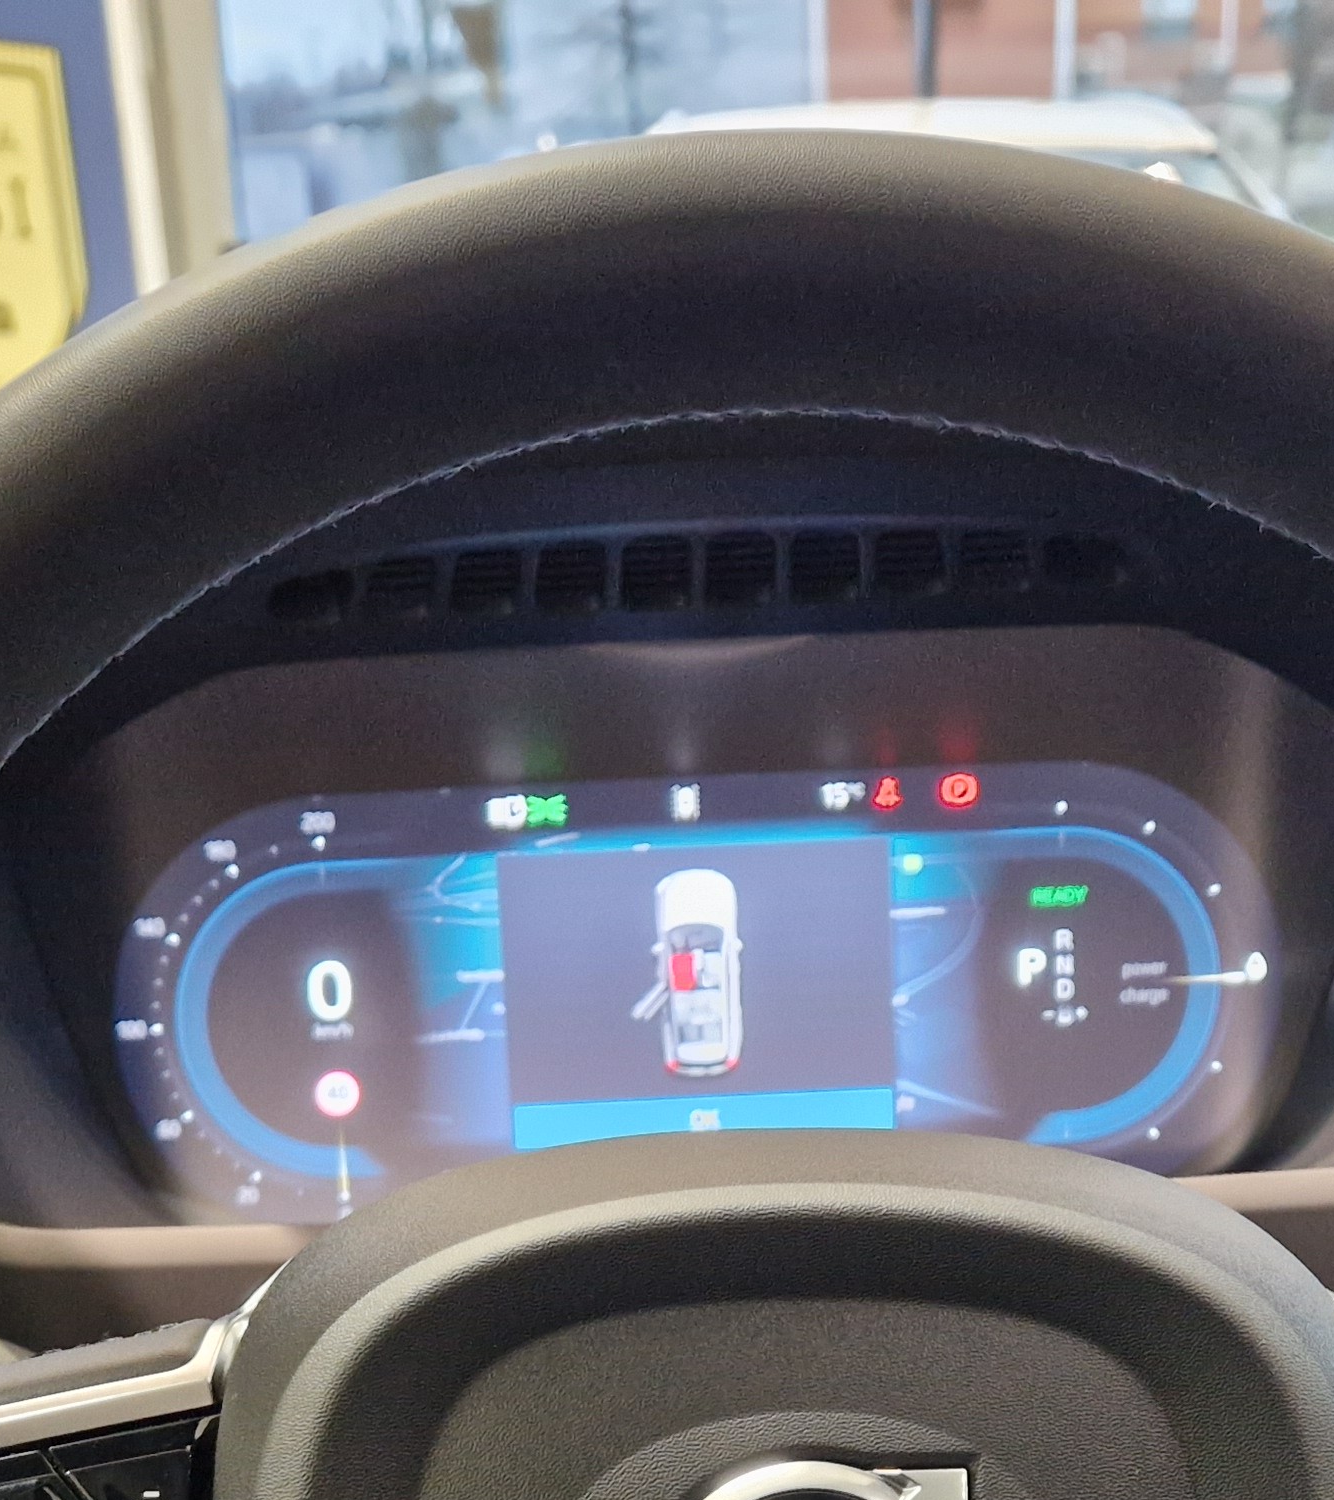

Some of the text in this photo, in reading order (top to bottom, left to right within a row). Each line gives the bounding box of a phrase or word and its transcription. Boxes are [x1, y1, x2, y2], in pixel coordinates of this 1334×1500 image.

[1031, 885, 1090, 907] READY
[1018, 947, 1048, 987] P
[307, 959, 353, 1021] 0
